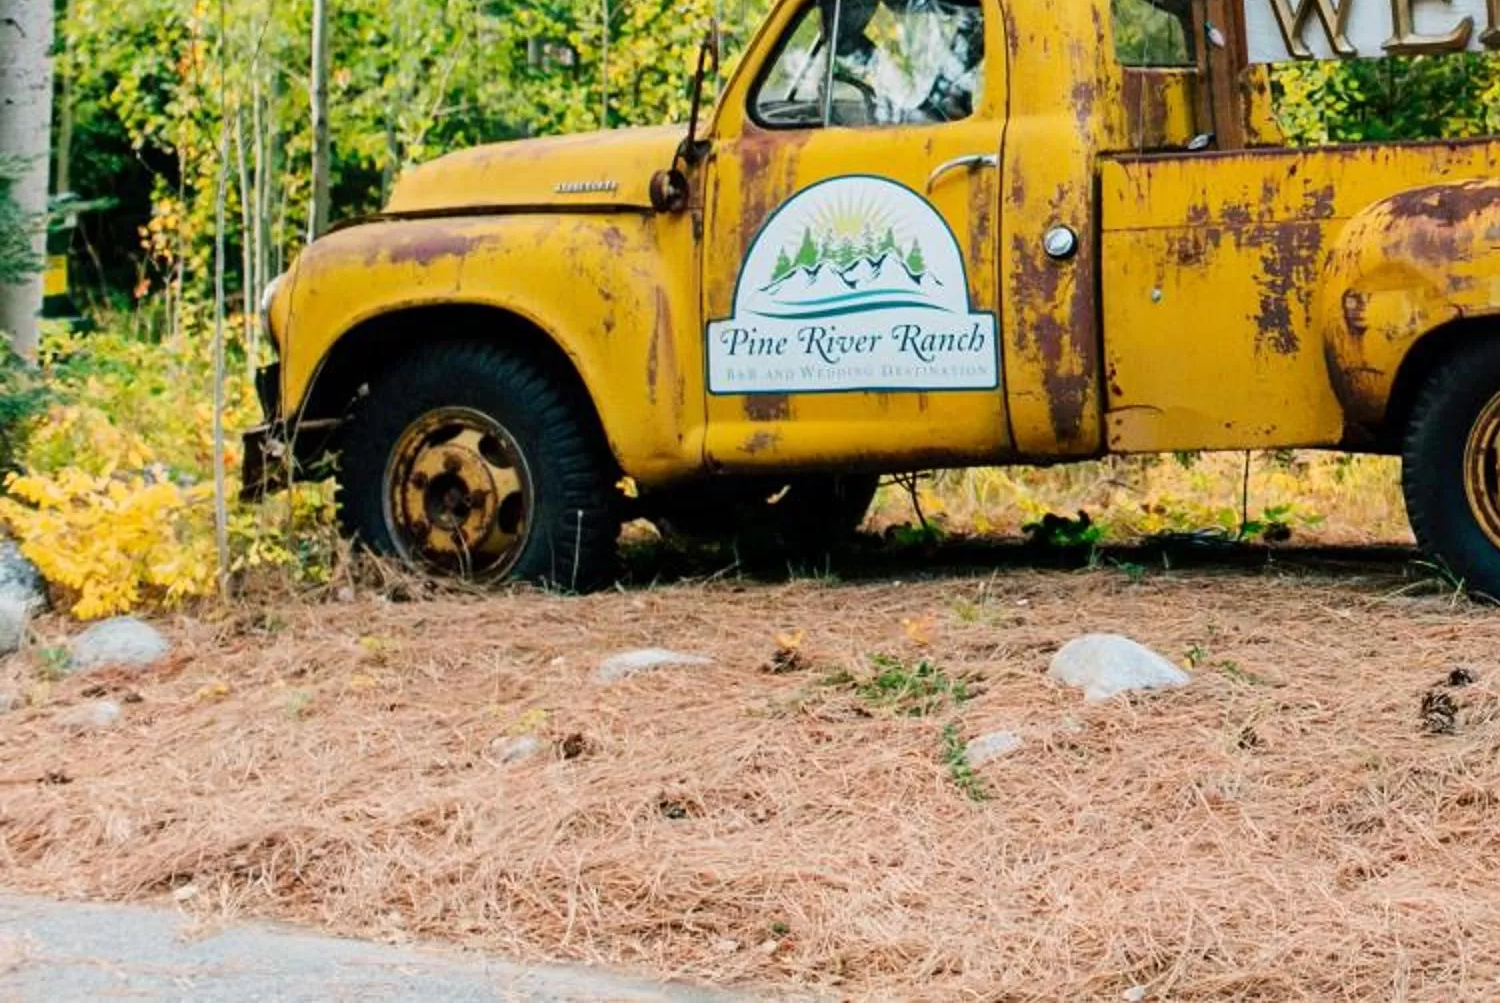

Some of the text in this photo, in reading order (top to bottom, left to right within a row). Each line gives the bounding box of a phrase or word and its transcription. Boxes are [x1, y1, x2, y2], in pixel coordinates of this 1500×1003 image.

[720, 322, 985, 364] Pine River Ranch
